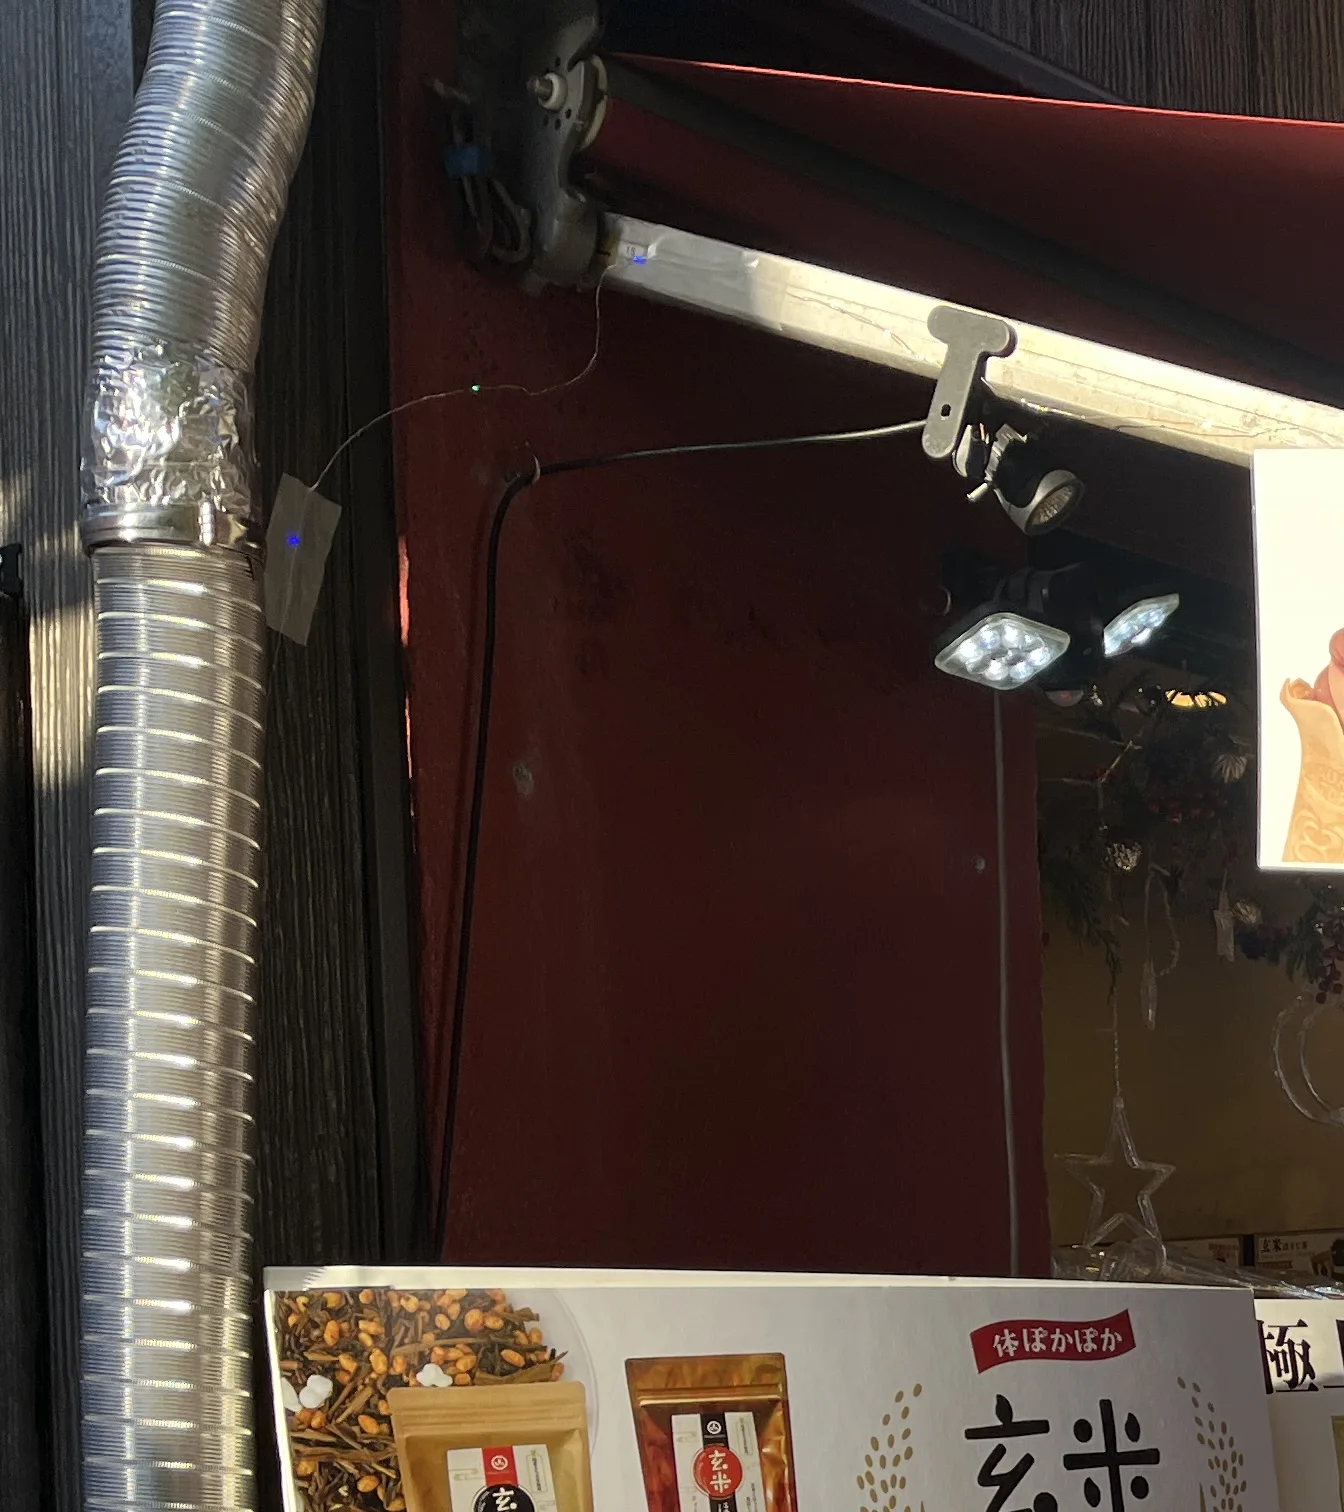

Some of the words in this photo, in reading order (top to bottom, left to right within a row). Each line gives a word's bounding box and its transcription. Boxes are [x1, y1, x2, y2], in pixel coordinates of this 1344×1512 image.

[992, 1323, 1124, 1356] 体ぽかぽか
[708, 1449, 732, 1493] 玄米
